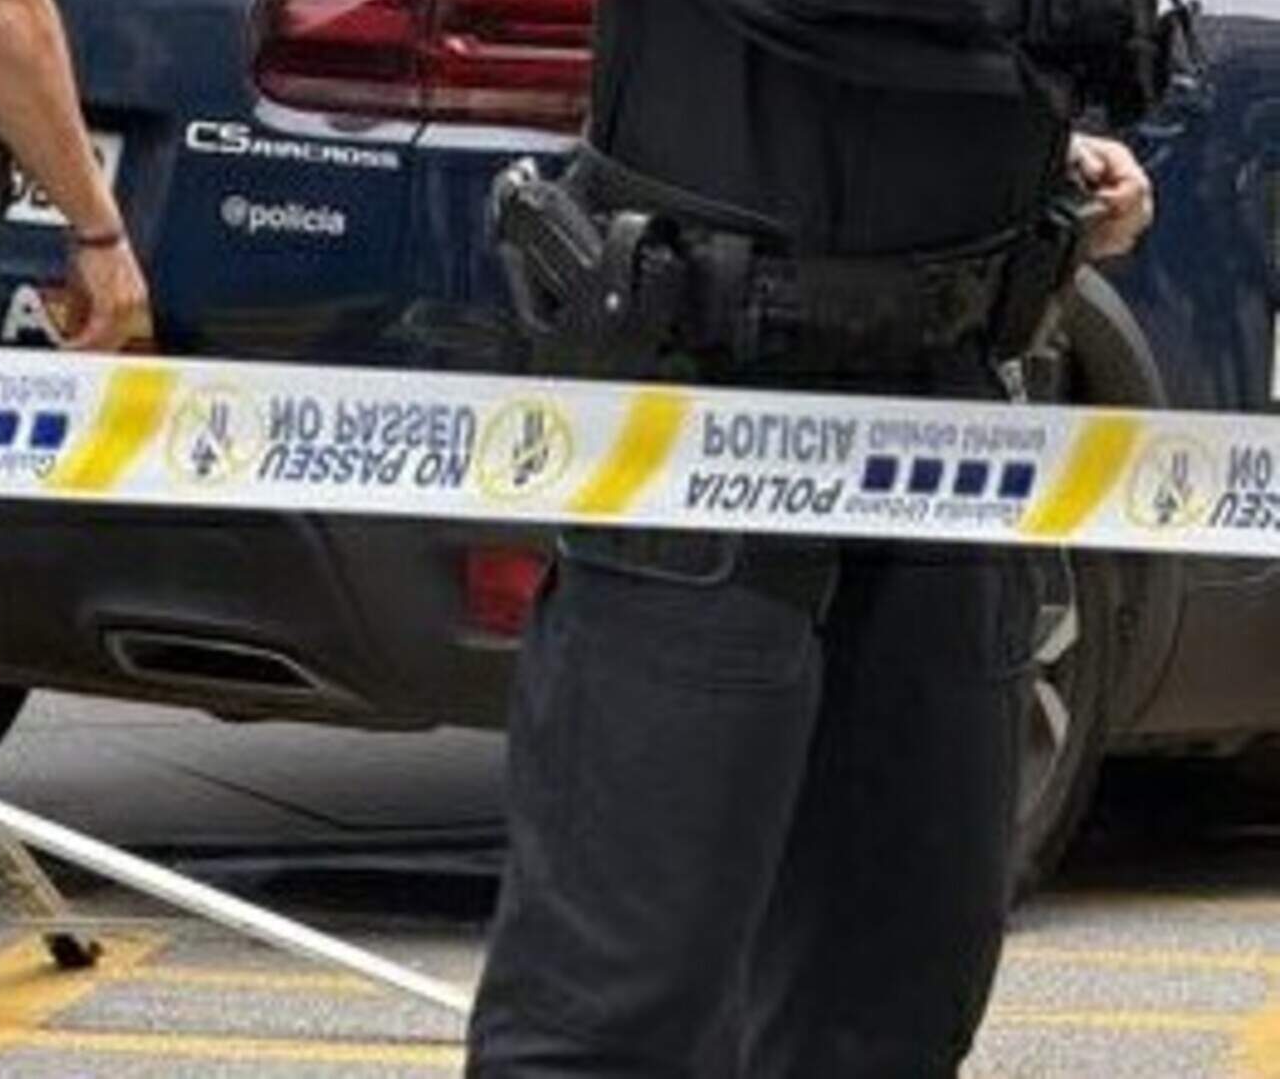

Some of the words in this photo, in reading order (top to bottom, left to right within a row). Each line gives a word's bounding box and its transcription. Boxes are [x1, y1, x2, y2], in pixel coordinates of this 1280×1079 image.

[220, 195, 346, 236] @policia
[258, 443, 408, 484] PASSEU
[415, 451, 470, 488] NO
[687, 472, 843, 514] POLICIA
